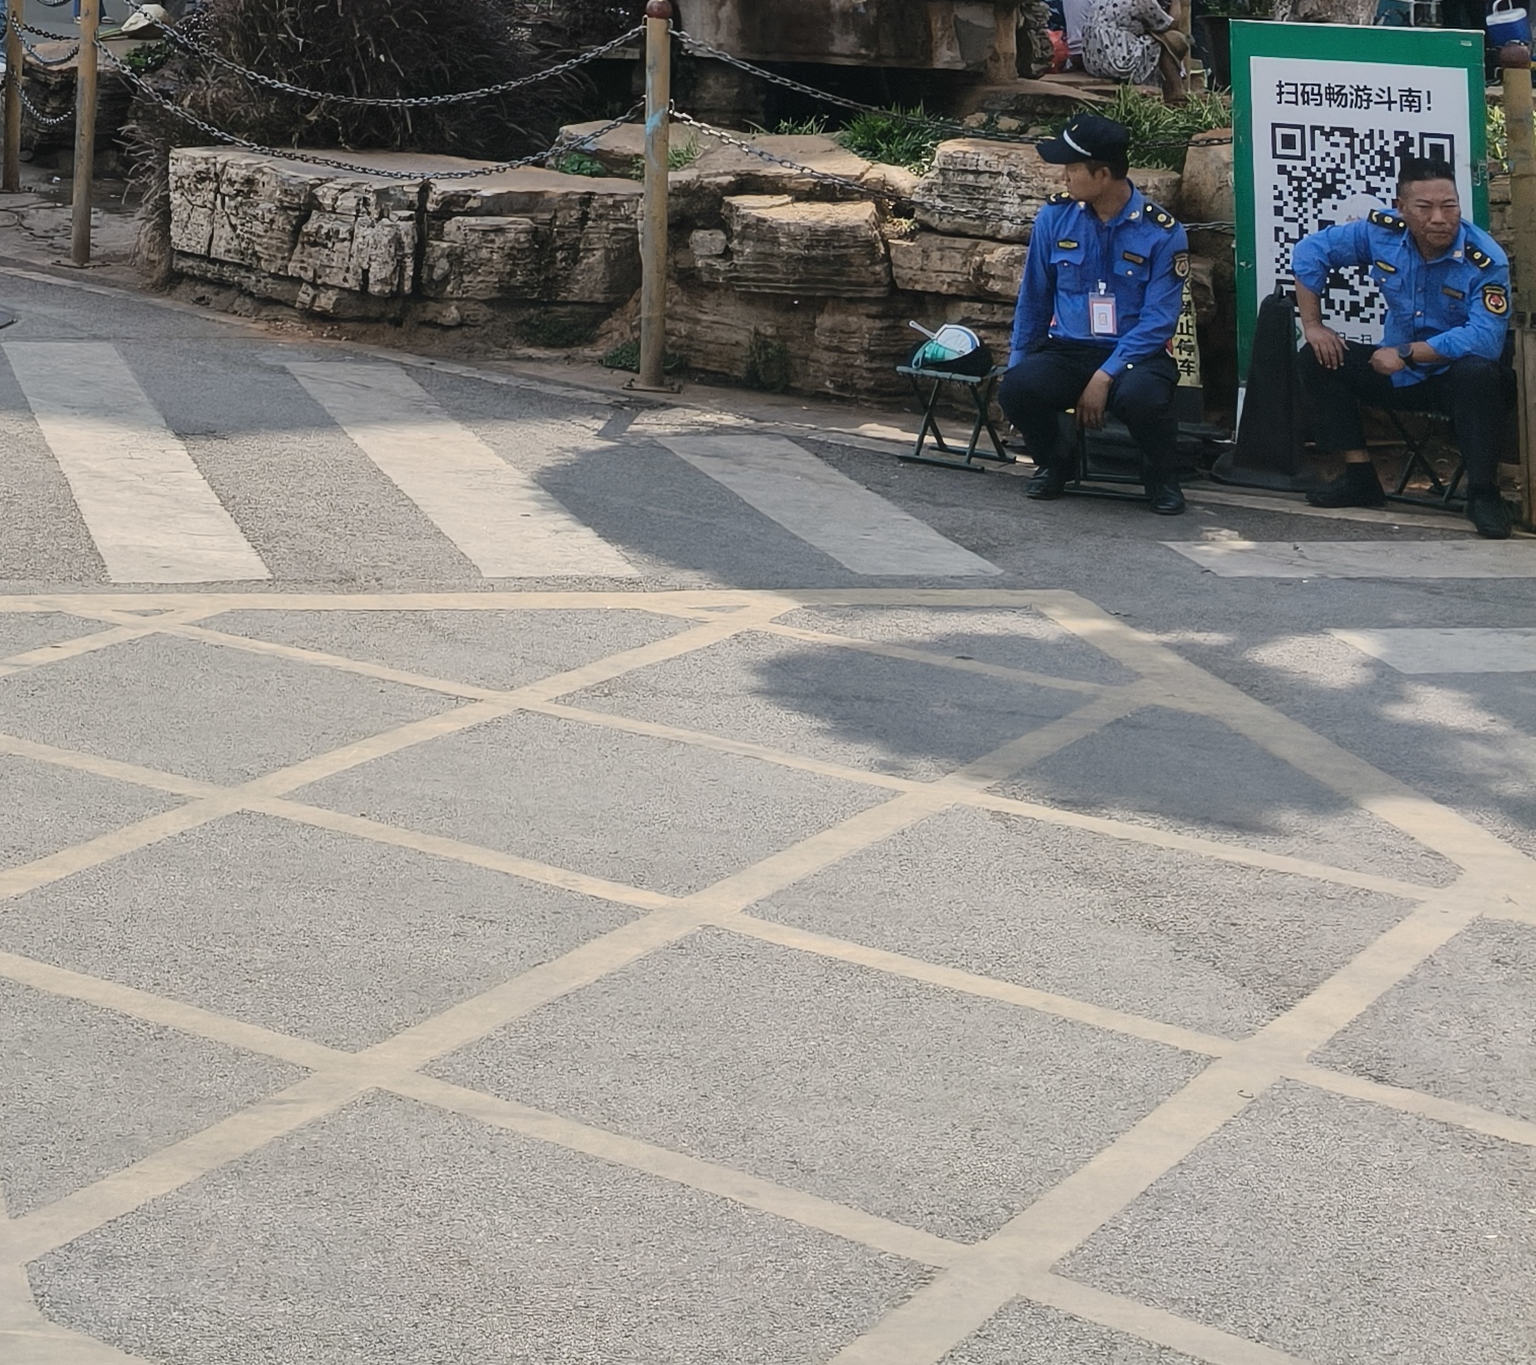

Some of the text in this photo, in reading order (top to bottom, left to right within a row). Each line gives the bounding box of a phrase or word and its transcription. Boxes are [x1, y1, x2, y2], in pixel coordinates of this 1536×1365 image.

[1275, 80, 1433, 114] 扫码畅游斗南!
